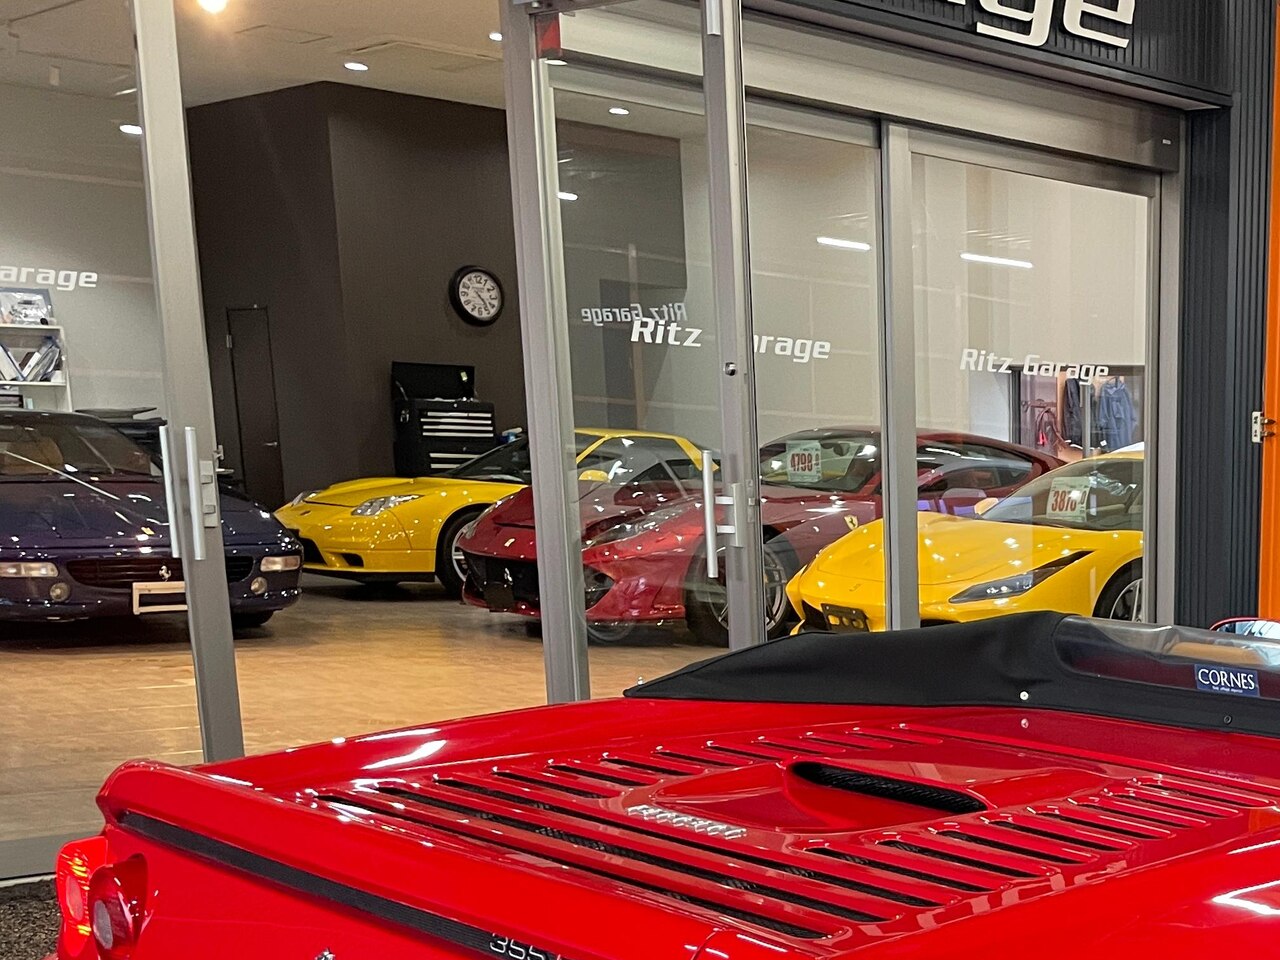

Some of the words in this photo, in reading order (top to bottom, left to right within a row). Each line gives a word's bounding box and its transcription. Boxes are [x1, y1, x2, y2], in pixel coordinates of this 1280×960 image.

[947, 0, 1136, 48] ge
[631, 317, 702, 347] Ritz
[753, 335, 831, 363] rage
[960, 348, 1014, 374] Ritz
[1023, 354, 1109, 386] Garage
[1198, 668, 1254, 690] CORNES
